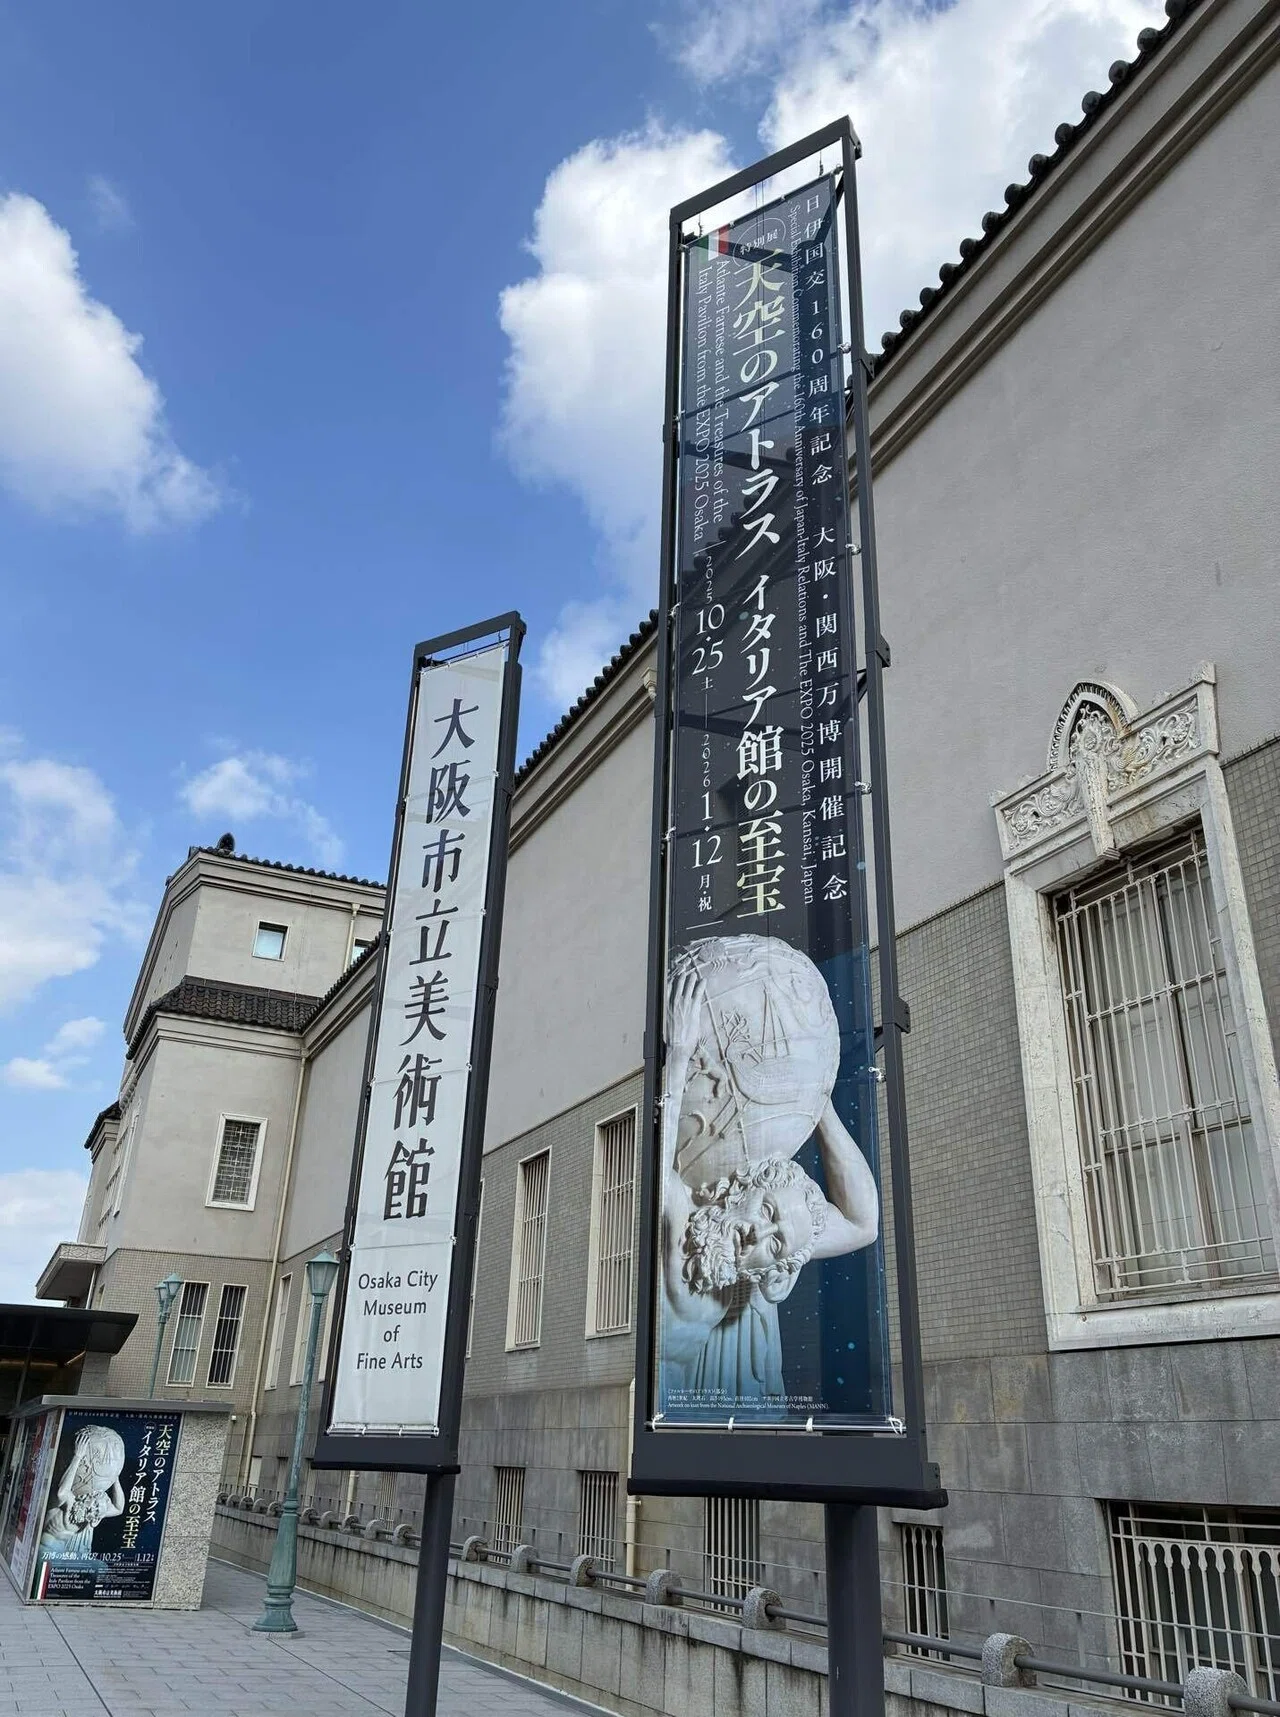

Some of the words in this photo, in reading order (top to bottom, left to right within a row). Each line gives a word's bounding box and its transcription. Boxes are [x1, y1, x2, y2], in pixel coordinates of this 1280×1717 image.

[788, 204, 801, 238] Special
[696, 266, 712, 294] Italy
[716, 260, 730, 305] Atlante
[791, 238, 802, 288] Exhibition
[698, 295, 712, 348] Pavilion
[715, 305, 730, 356] Farnese
[791, 289, 803, 372] Commemorating
[803, 195, 833, 486] 日伊国交160周年記念
[697, 350, 711, 382] from
[715, 358, 729, 384] and
[794, 373, 805, 390] the
[697, 384, 711, 408] the
[714, 386, 730, 409] the
[733, 248, 785, 561] 天空のアトラス
[794, 392, 806, 423] 160th
[696, 407, 710, 452] EXPO
[714, 408, 728, 477] Treasures
[695, 454, 710, 491] 2025
[794, 425, 806, 487] Anniversary
[714, 480, 729, 496] of
[796, 490, 808, 502] of
[694, 494, 709, 542] Osaka
[714, 498, 729, 523] the
[794, 503, 811, 563] Japan-Italy
[705, 556, 714, 604] 2025
[797, 565, 811, 622] Relations
[798, 624, 812, 649] and
[701, 676, 714, 690] 土
[799, 649, 813, 677] The
[800, 678, 814, 719] EXPO
[813, 527, 848, 901] 大阪・関西万博開催記念
[702, 734, 711, 787] 2026
[736, 575, 785, 919] イタリア館の至宝
[800, 722, 814, 756] 2025
[801, 759, 816, 806] Osaka,
[801, 809, 816, 860] Kansai,
[800, 864, 817, 904] Japan
[384, 699, 479, 1221] 大阪市立美術館
[358, 1271, 402, 1290] Osaka
[407, 1270, 438, 1292] City
[363, 1299, 427, 1316] Museum
[383, 1324, 401, 1342] of
[357, 1353, 386, 1369] Fine
[391, 1352, 423, 1369] Arts
[121, 1431, 153, 1549] イタリア館の至宝
[143, 1424, 174, 1522] 天空のアトラス
